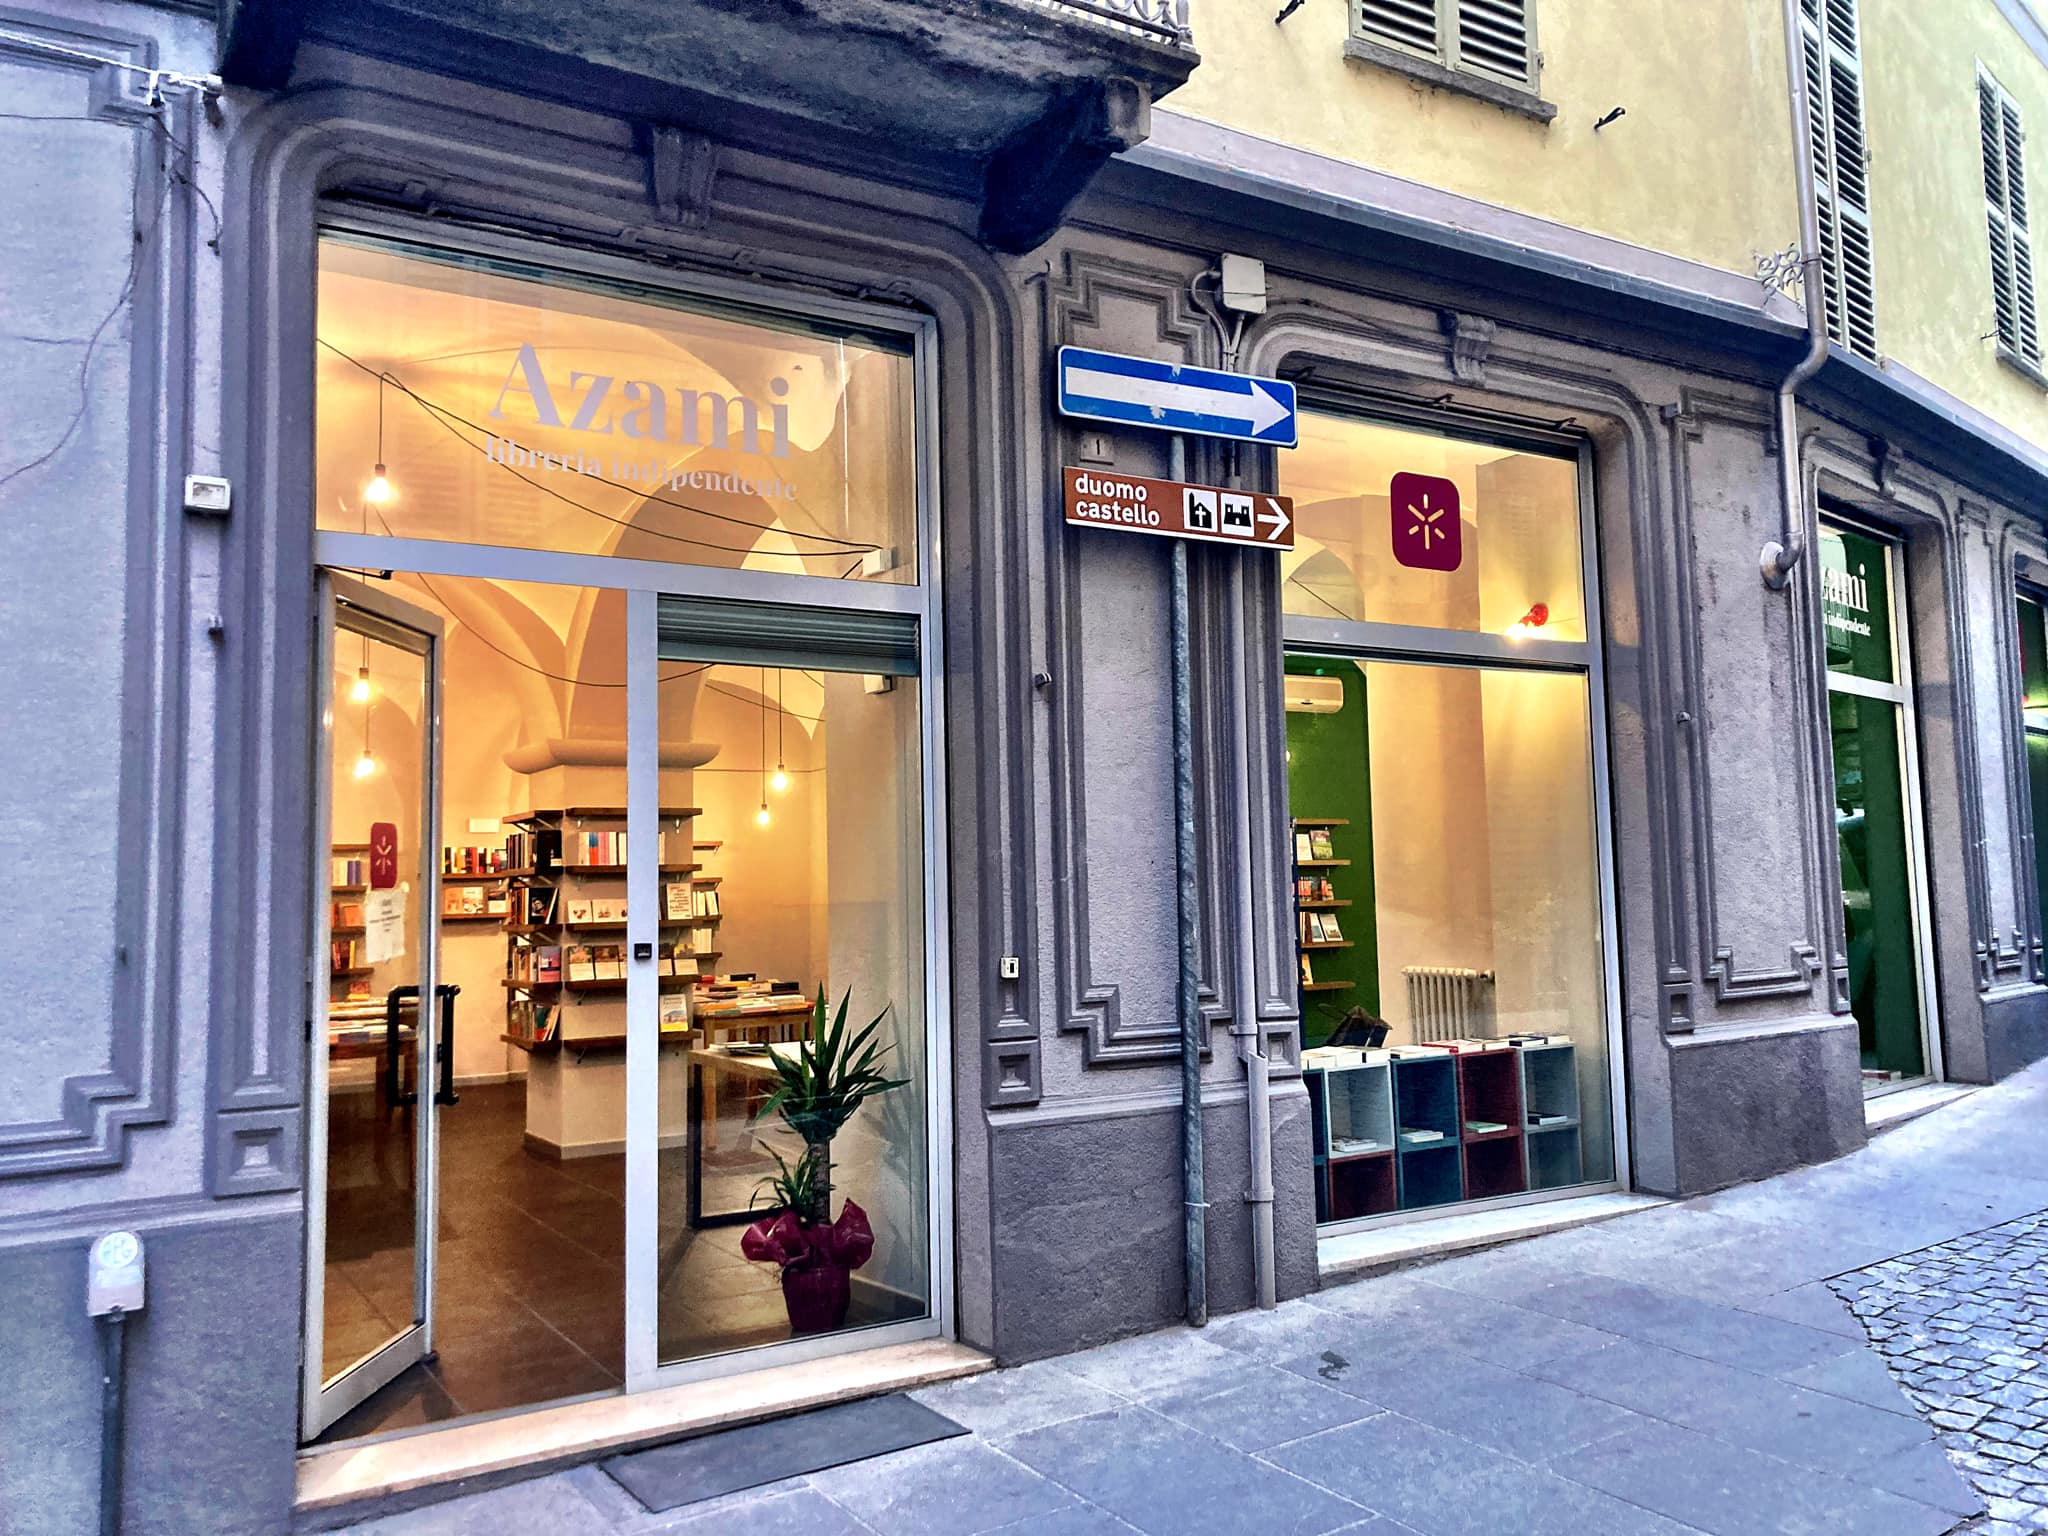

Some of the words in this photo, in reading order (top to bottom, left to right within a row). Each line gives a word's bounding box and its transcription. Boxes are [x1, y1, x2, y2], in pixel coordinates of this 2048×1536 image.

[488, 342, 791, 459] Azami
[486, 434, 601, 477] libreria
[611, 453, 798, 500] indipendente
[1075, 473, 1148, 502] duomo
[1075, 499, 1160, 526] castello
